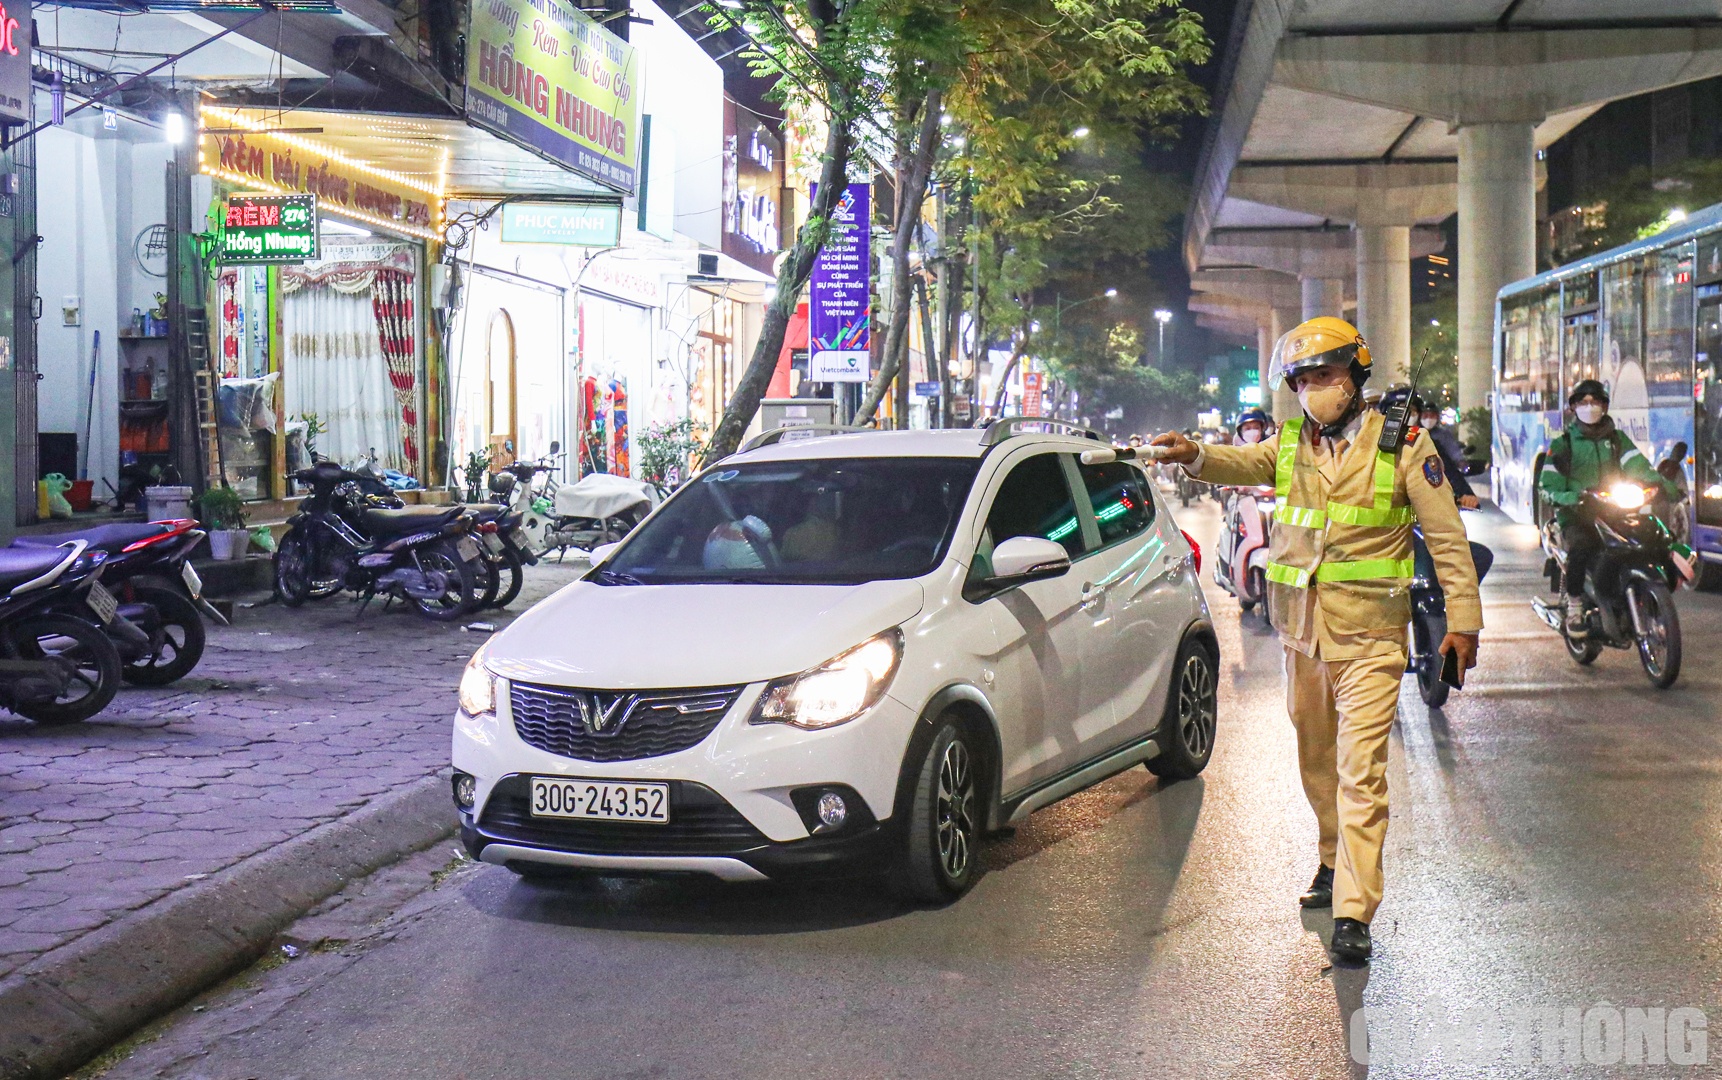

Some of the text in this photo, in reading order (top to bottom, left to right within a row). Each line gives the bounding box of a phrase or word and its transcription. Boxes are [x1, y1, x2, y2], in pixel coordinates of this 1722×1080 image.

[548, 0, 574, 35] TRANG
[532, 19, 559, 58] Rèm
[592, 59, 611, 90] Cao
[478, 39, 626, 157] HỒNG NHUNG
[104, 111, 116, 127] 276
[220, 133, 265, 180] RÈM
[270, 148, 299, 190] VẢI
[226, 201, 308, 227] RÈM 274
[560, 216, 605, 230] MINH
[226, 231, 311, 253] Hồng Nhung
[816, 280, 864, 290] SỰ PHÁT TRIỂN
[831, 272, 849, 280] CÙNG
[833, 290, 847, 298] CỦA
[825, 309, 840, 317] VIỆT
[820, 366, 861, 374] Vietcombank
[535, 783, 664, 818] 30G-243.52
